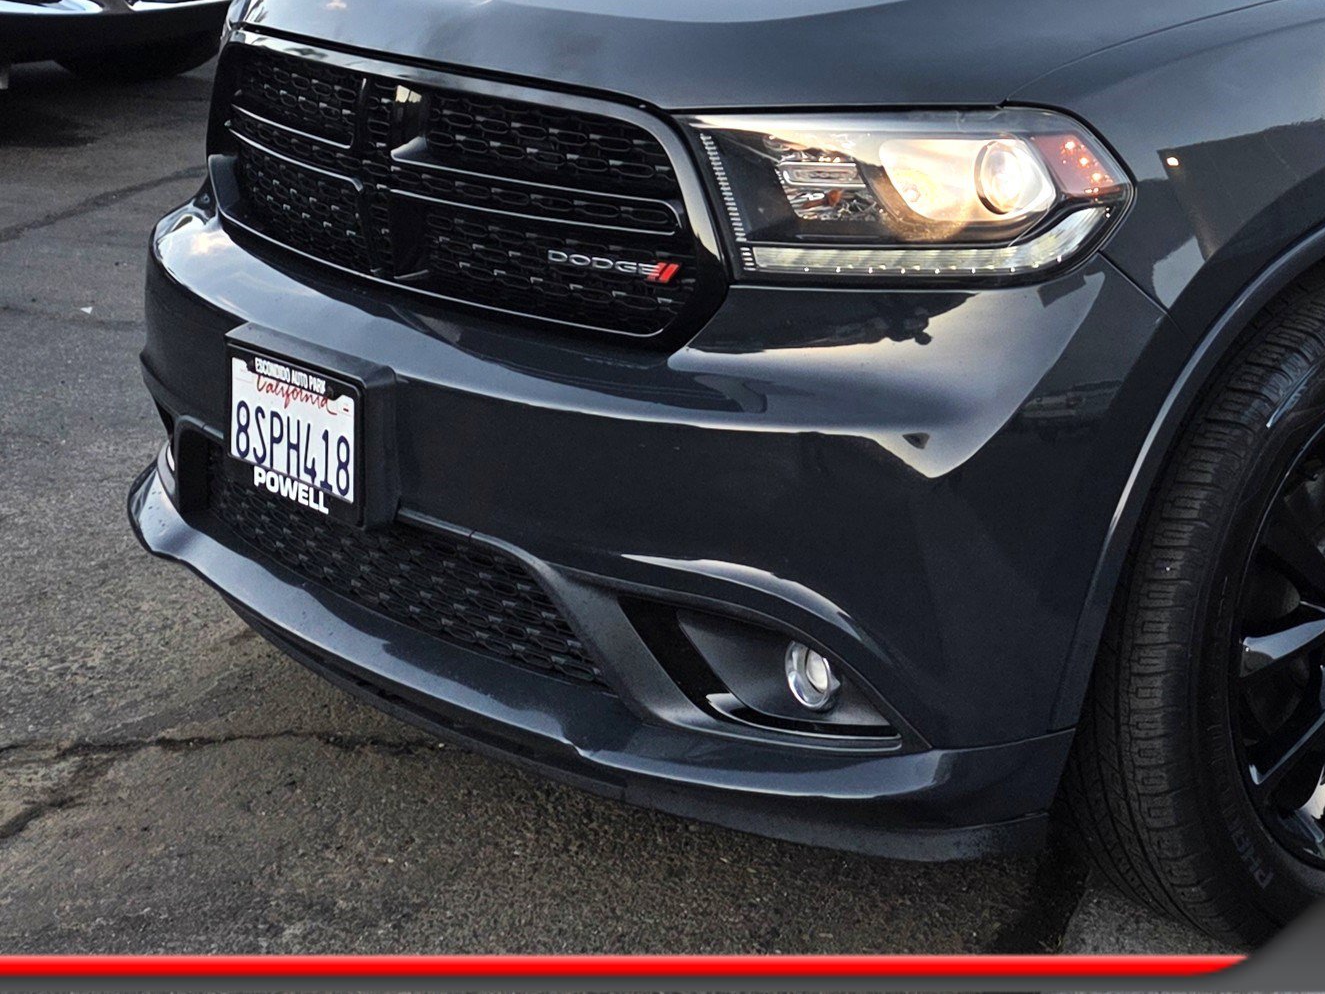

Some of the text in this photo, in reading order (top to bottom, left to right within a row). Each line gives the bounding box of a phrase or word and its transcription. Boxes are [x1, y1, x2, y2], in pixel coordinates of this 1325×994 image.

[548, 249, 660, 277] DODGE
[256, 373, 338, 416] California
[291, 369, 309, 390] AUTO
[308, 374, 326, 395] PARK
[235, 400, 351, 497] 8SPH418
[253, 465, 330, 515] POWELL
